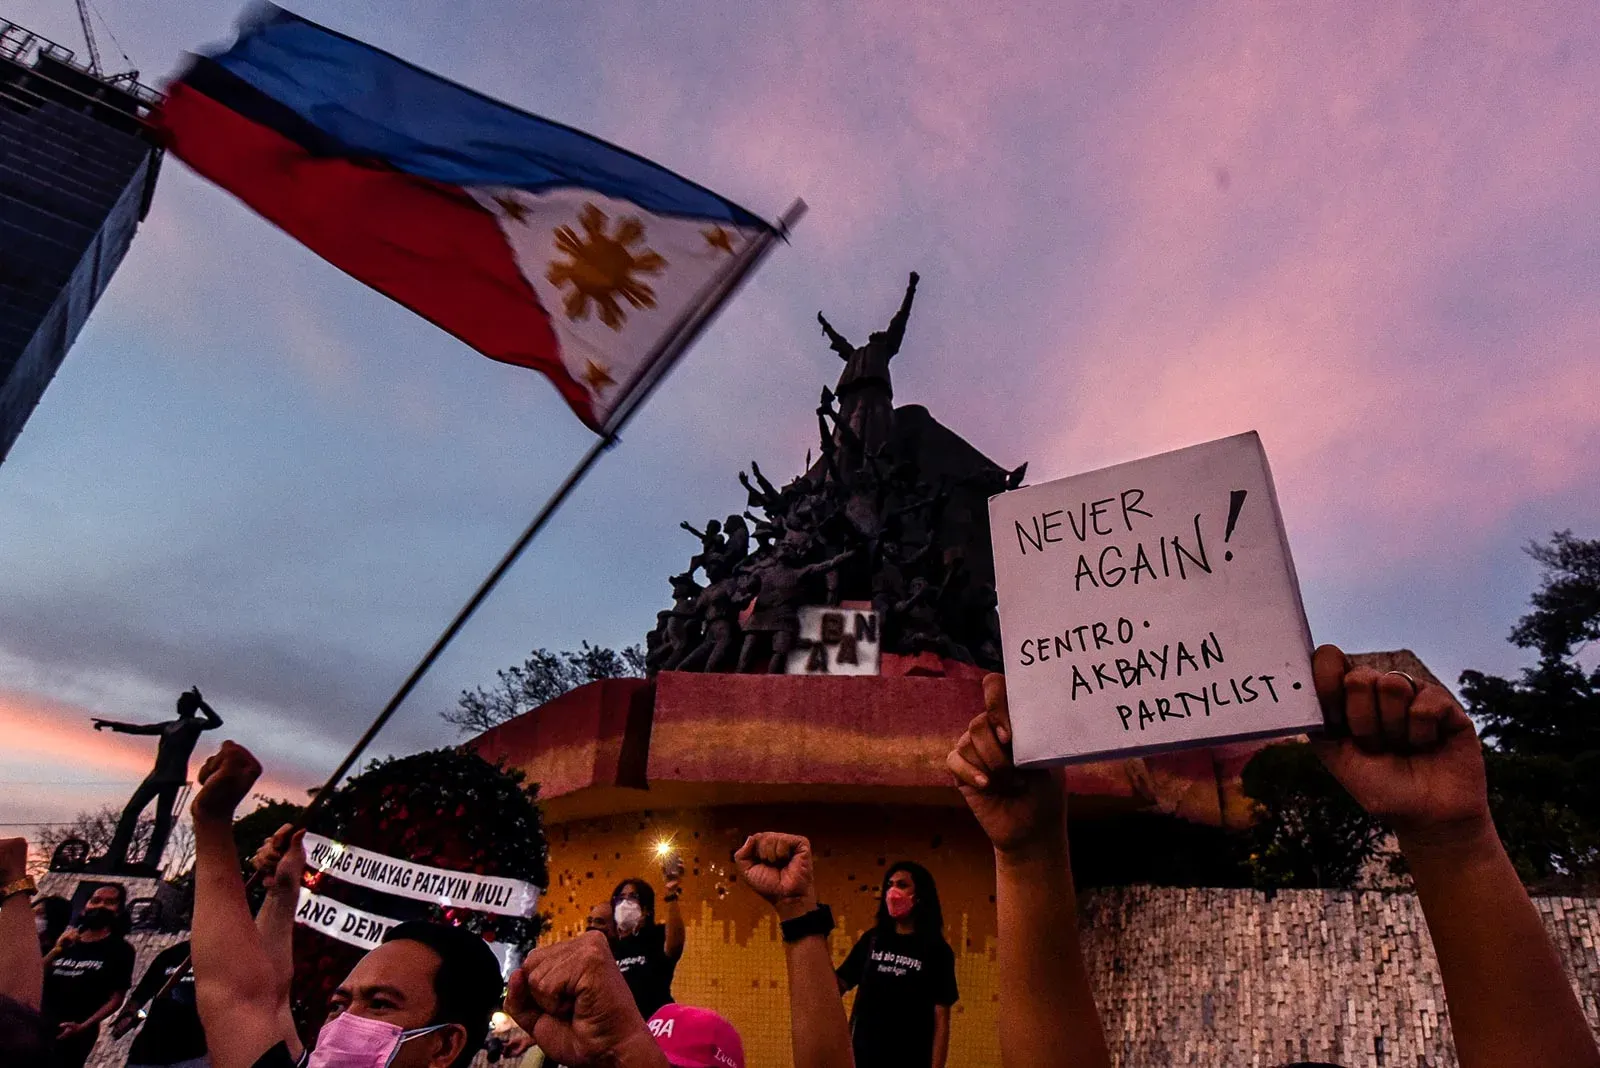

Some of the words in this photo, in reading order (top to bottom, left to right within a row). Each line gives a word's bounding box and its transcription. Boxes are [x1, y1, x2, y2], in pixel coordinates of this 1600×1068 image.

[1014, 489, 1153, 555] NEVER
[1074, 489, 1248, 592] AGAIN!
[1072, 632, 1224, 701] AKBAYAN
[311, 843, 353, 873] HUWAG
[352, 857, 413, 888] PUMAYAG
[412, 872, 472, 901] PATAYIN
[471, 881, 513, 908] MULI
[297, 899, 337, 927] ANG
